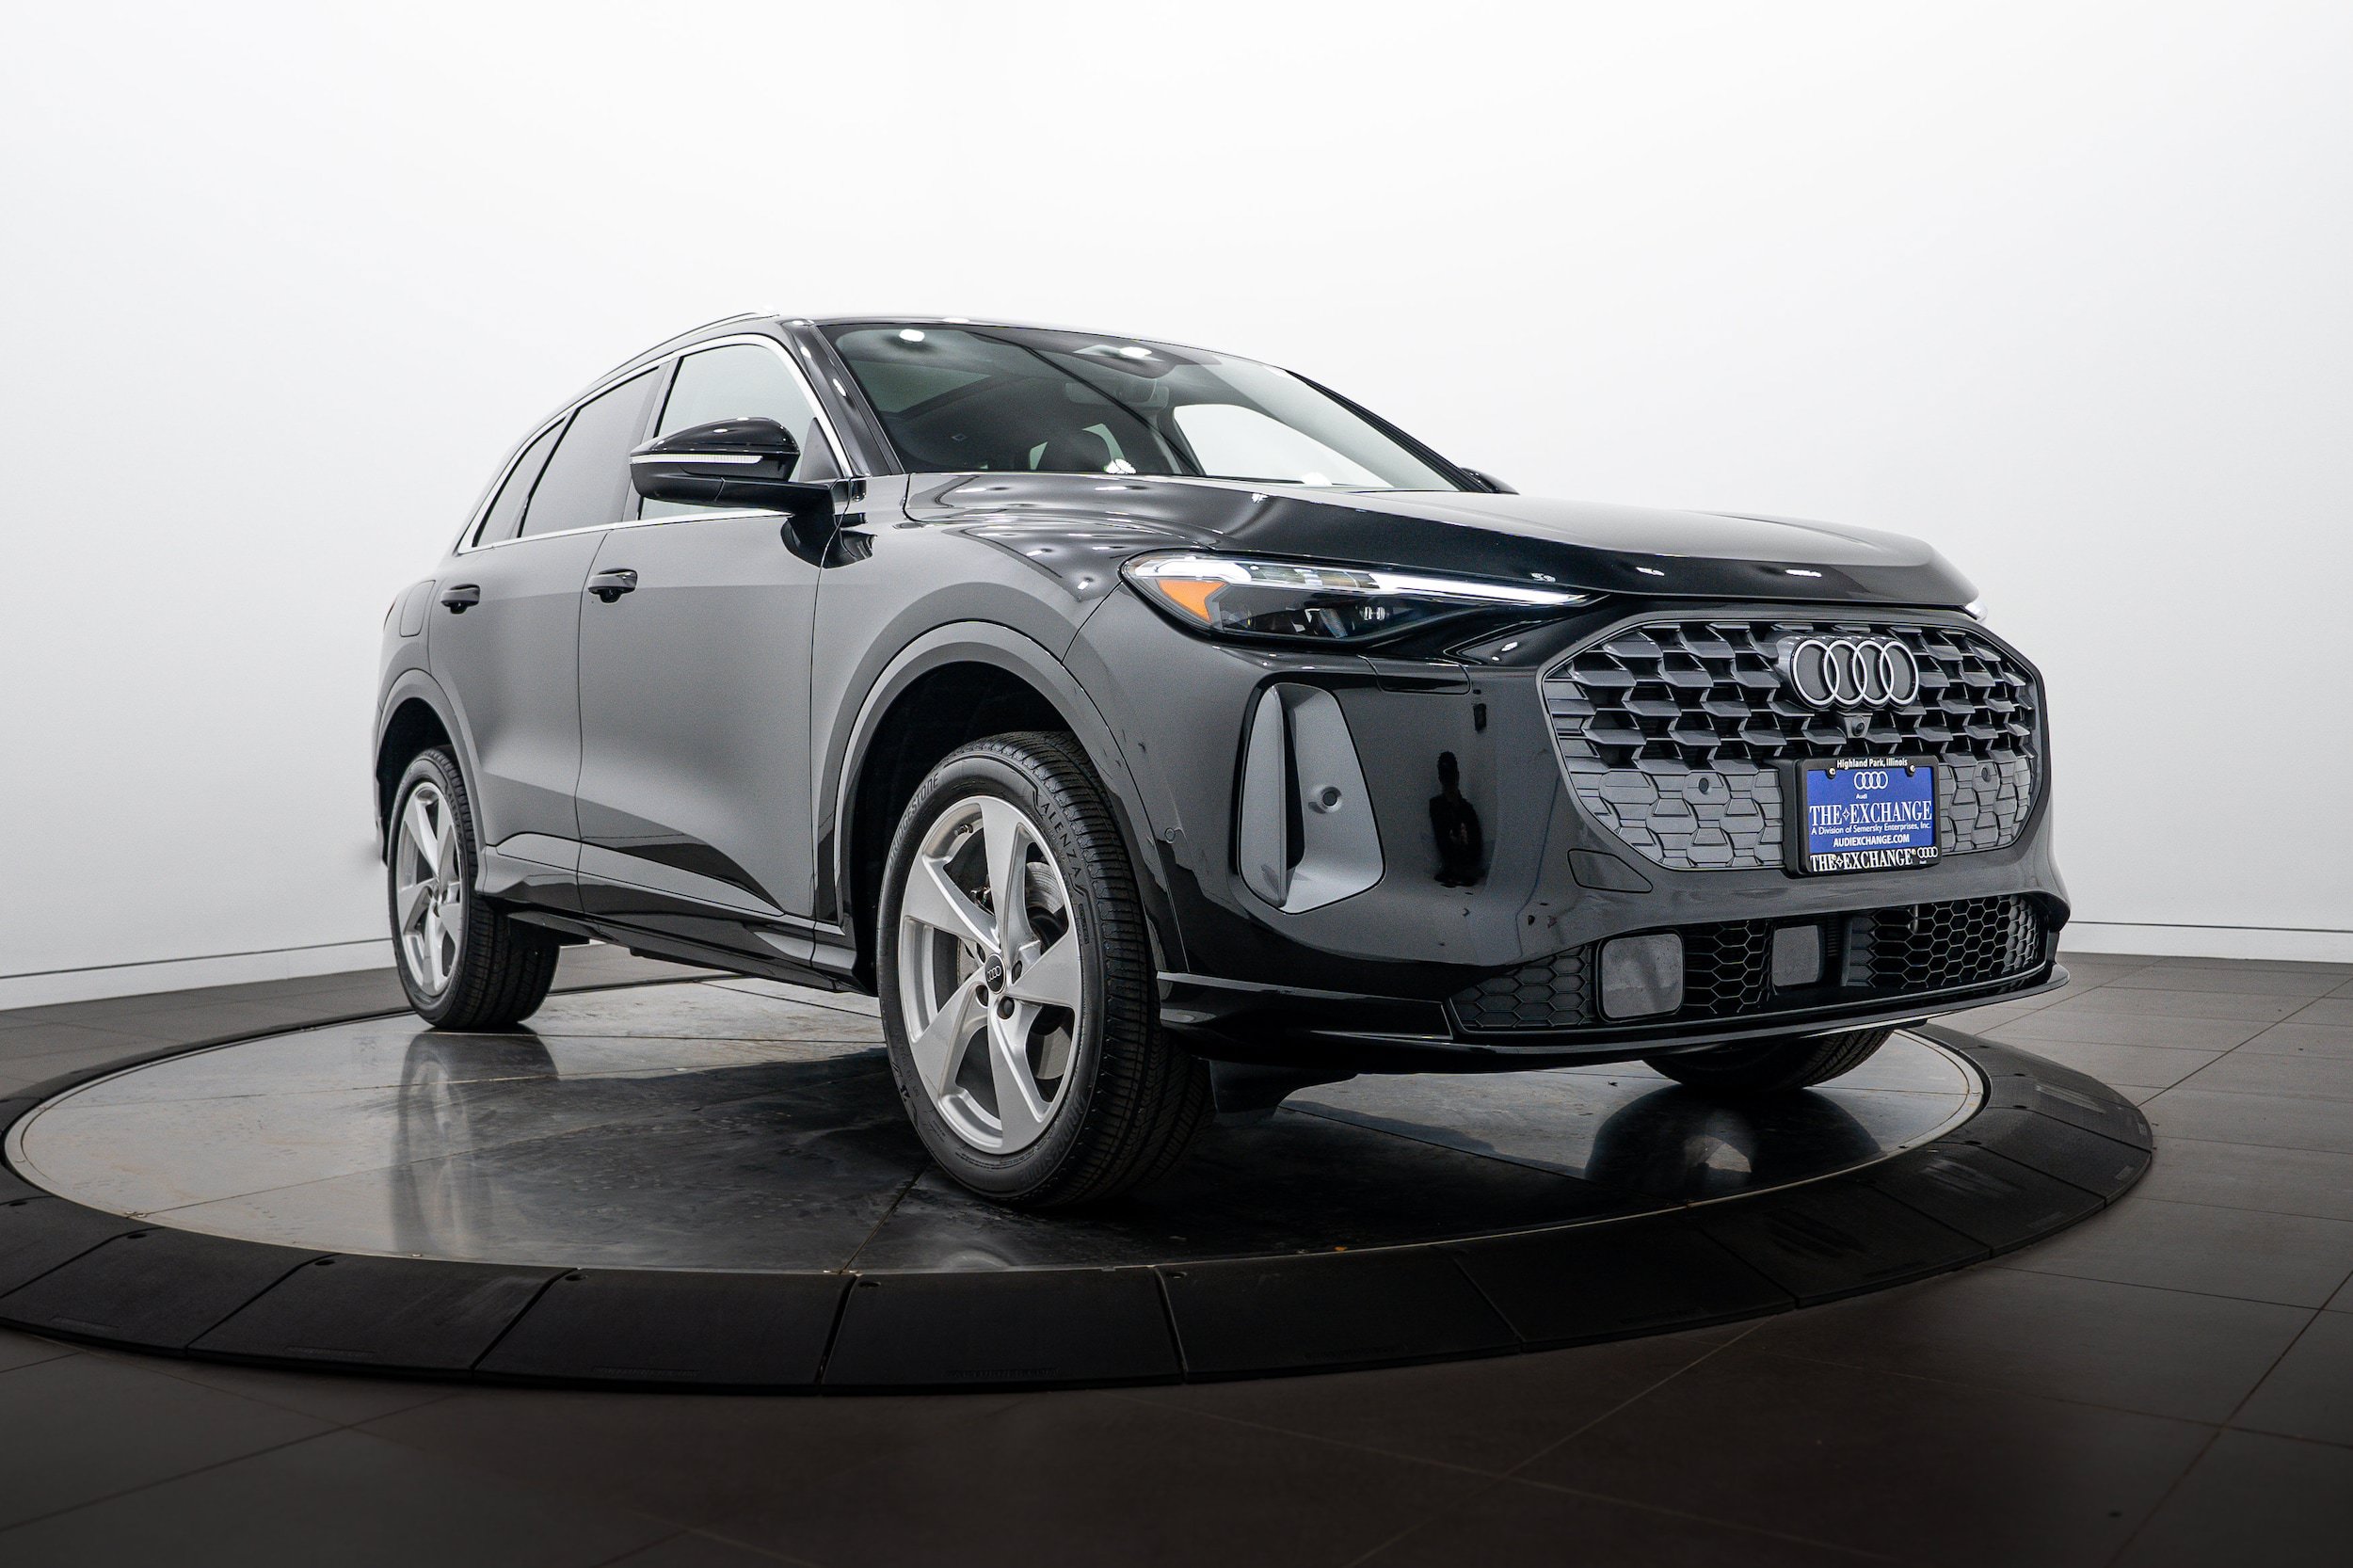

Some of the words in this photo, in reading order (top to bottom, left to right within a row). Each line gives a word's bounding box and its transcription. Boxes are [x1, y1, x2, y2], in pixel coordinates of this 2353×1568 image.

[1836, 758, 1868, 770] Highland
[1869, 758, 1885, 768] Park,
[1886, 757, 1908, 766] Illinois
[1809, 805, 1842, 826] THE
[1849, 800, 1932, 824] EXCHANGE
[1811, 827, 1817, 836] A
[1818, 826, 1844, 835] Division
[1845, 825, 1852, 834] of
[1853, 824, 1882, 834] Semersky
[1884, 823, 1919, 833] Enterprises,
[1041, 803, 1081, 879] ALENZA
[1833, 834, 1911, 848] AUDIEXCHANGE.COM
[1809, 854, 1837, 872] THE
[1841, 849, 1913, 870] EXCHANGE
